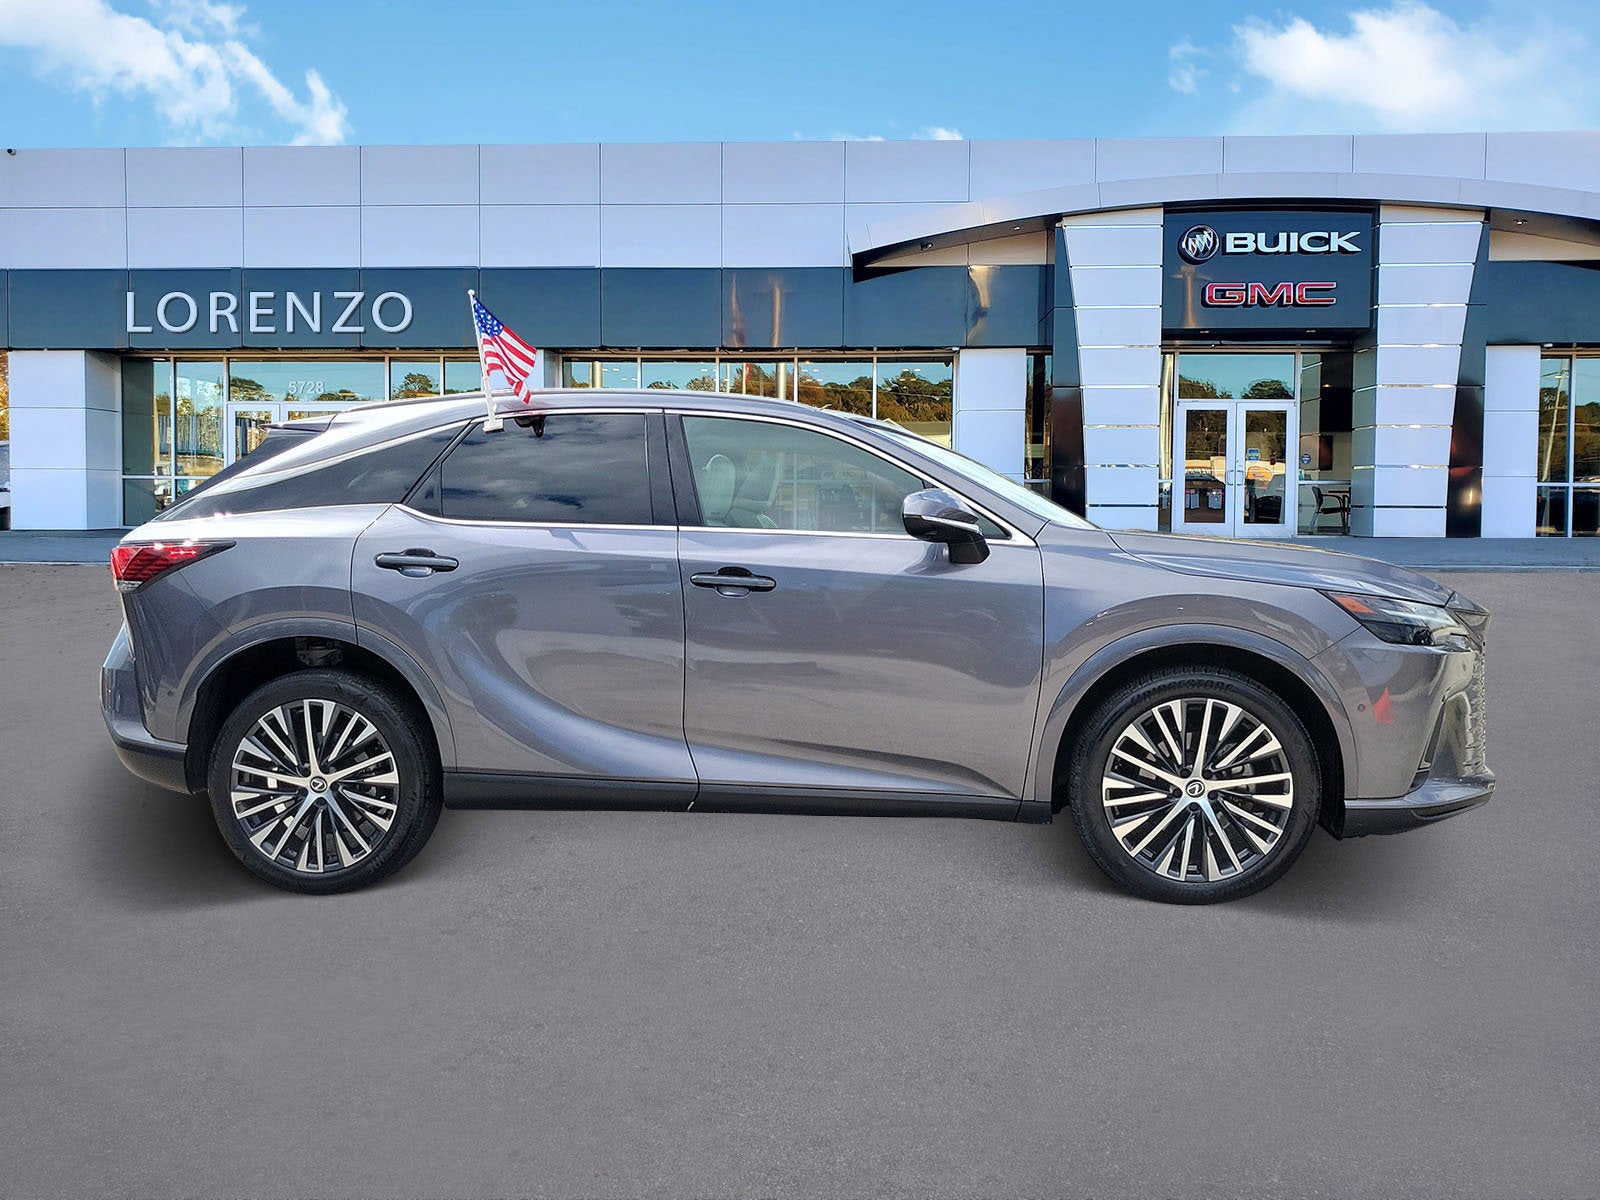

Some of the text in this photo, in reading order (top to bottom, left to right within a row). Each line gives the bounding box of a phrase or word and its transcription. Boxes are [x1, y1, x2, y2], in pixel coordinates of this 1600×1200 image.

[1225, 231, 1362, 253] BUICK
[1205, 281, 1337, 305] GMC
[126, 291, 413, 333] LORENZO
[288, 380, 325, 394] 5728
